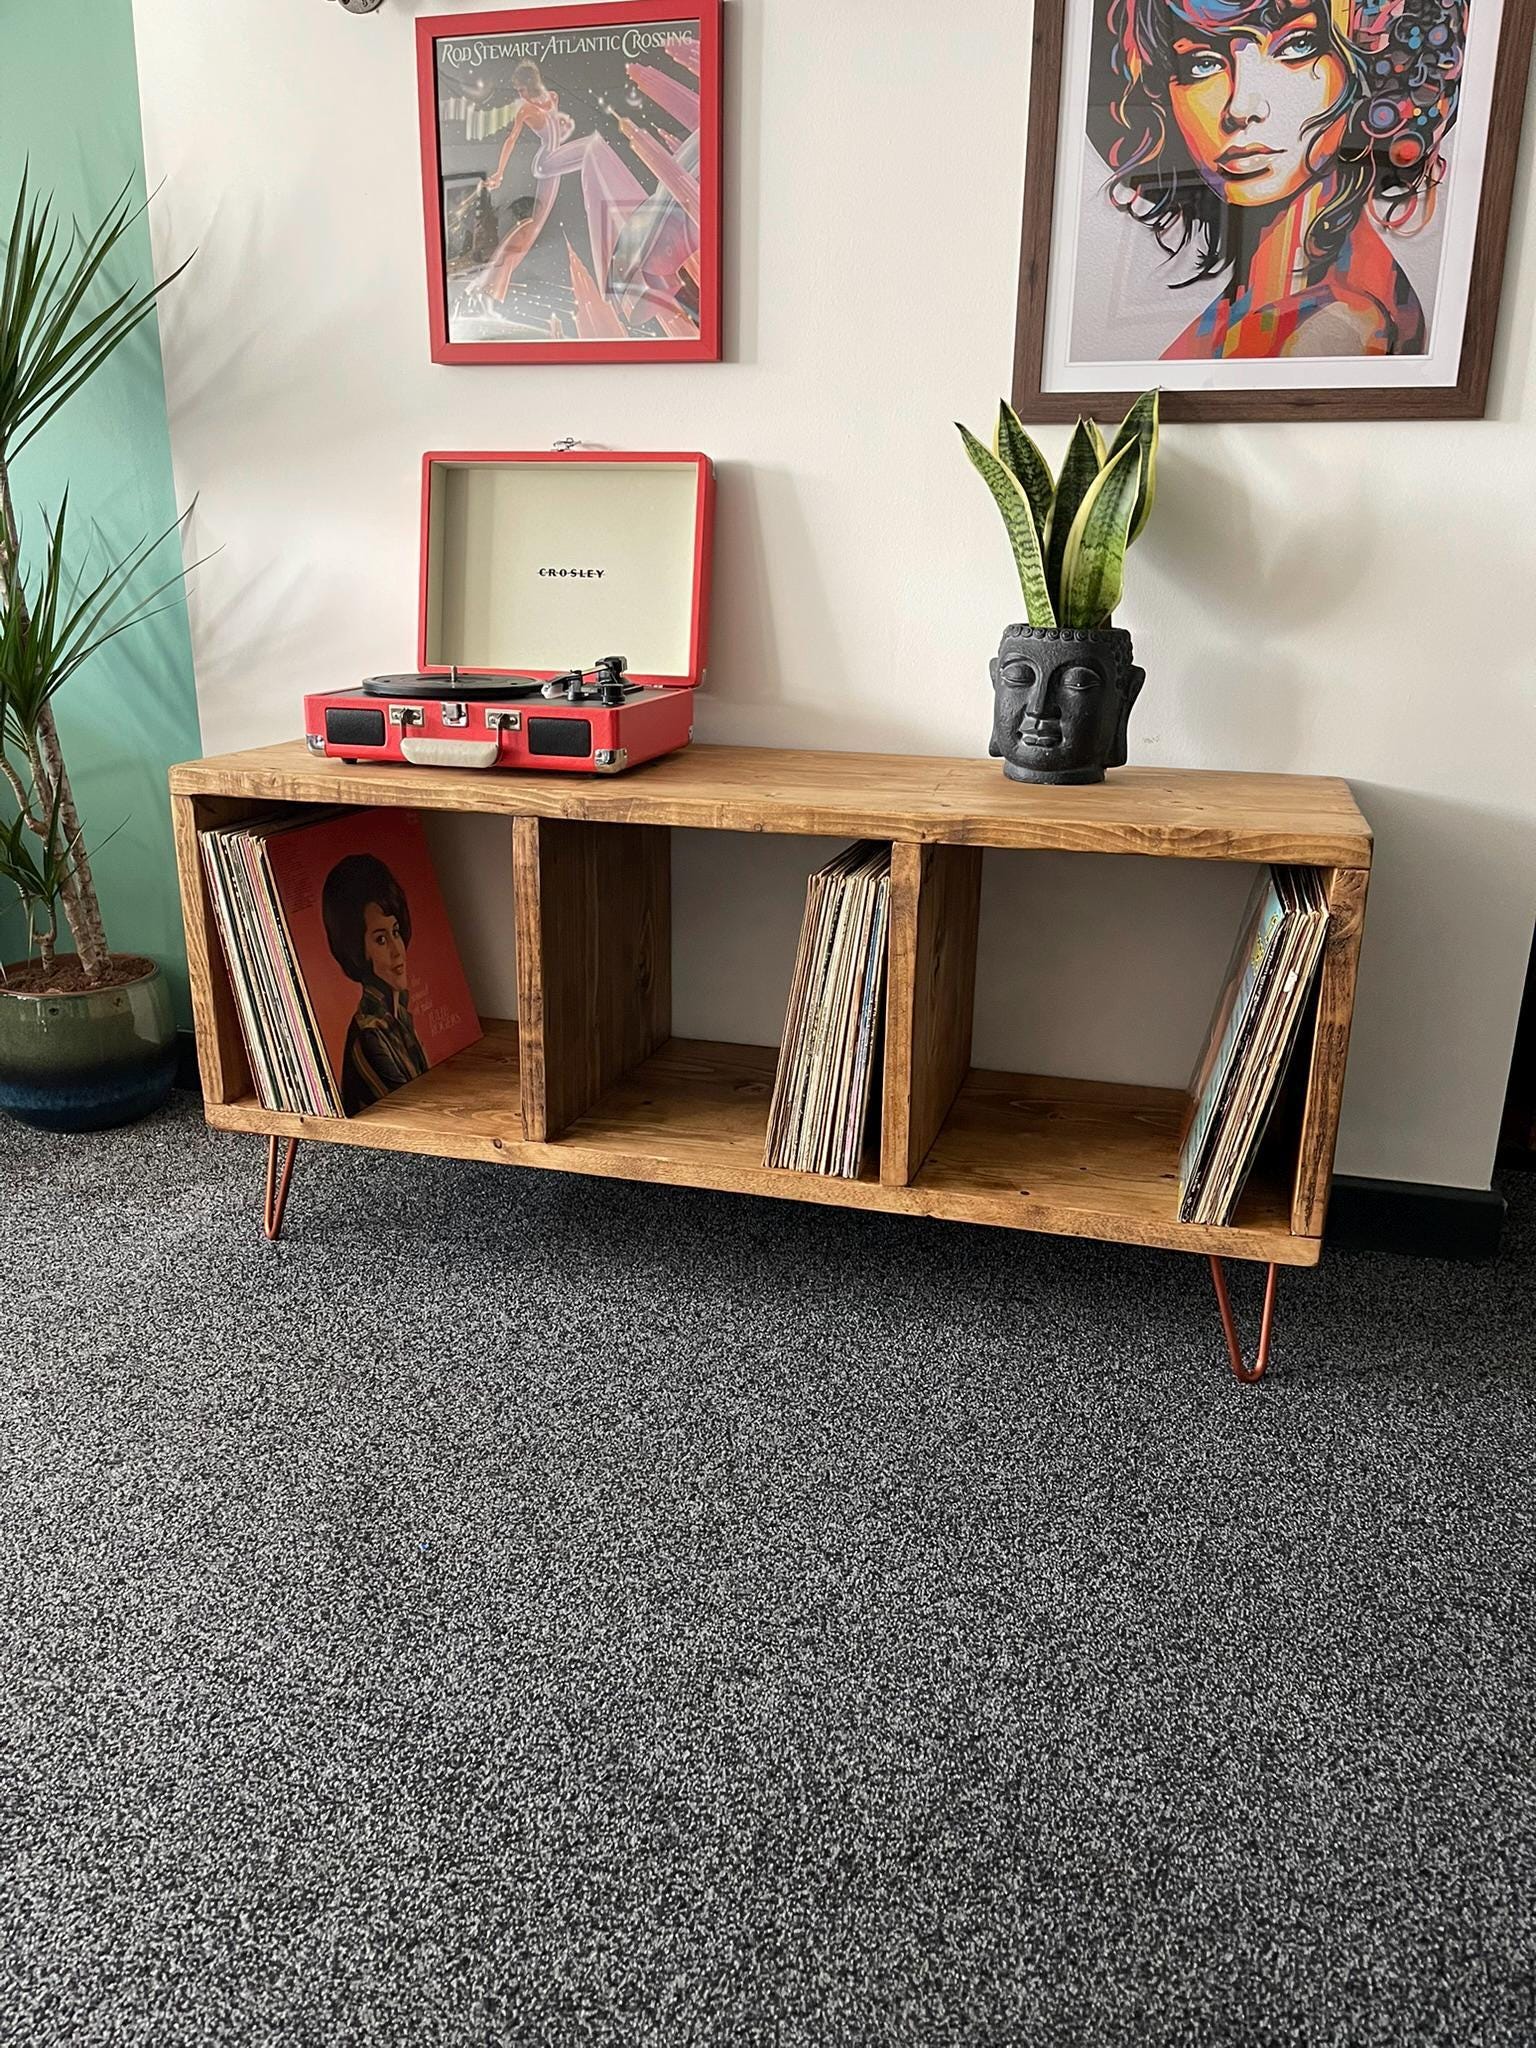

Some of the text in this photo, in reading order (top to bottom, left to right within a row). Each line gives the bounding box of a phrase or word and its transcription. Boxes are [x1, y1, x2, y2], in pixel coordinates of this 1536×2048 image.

[441, 29, 693, 68] ROD STEWART ATLANTIC CROSSING
[538, 567, 605, 579] CROSLEY
